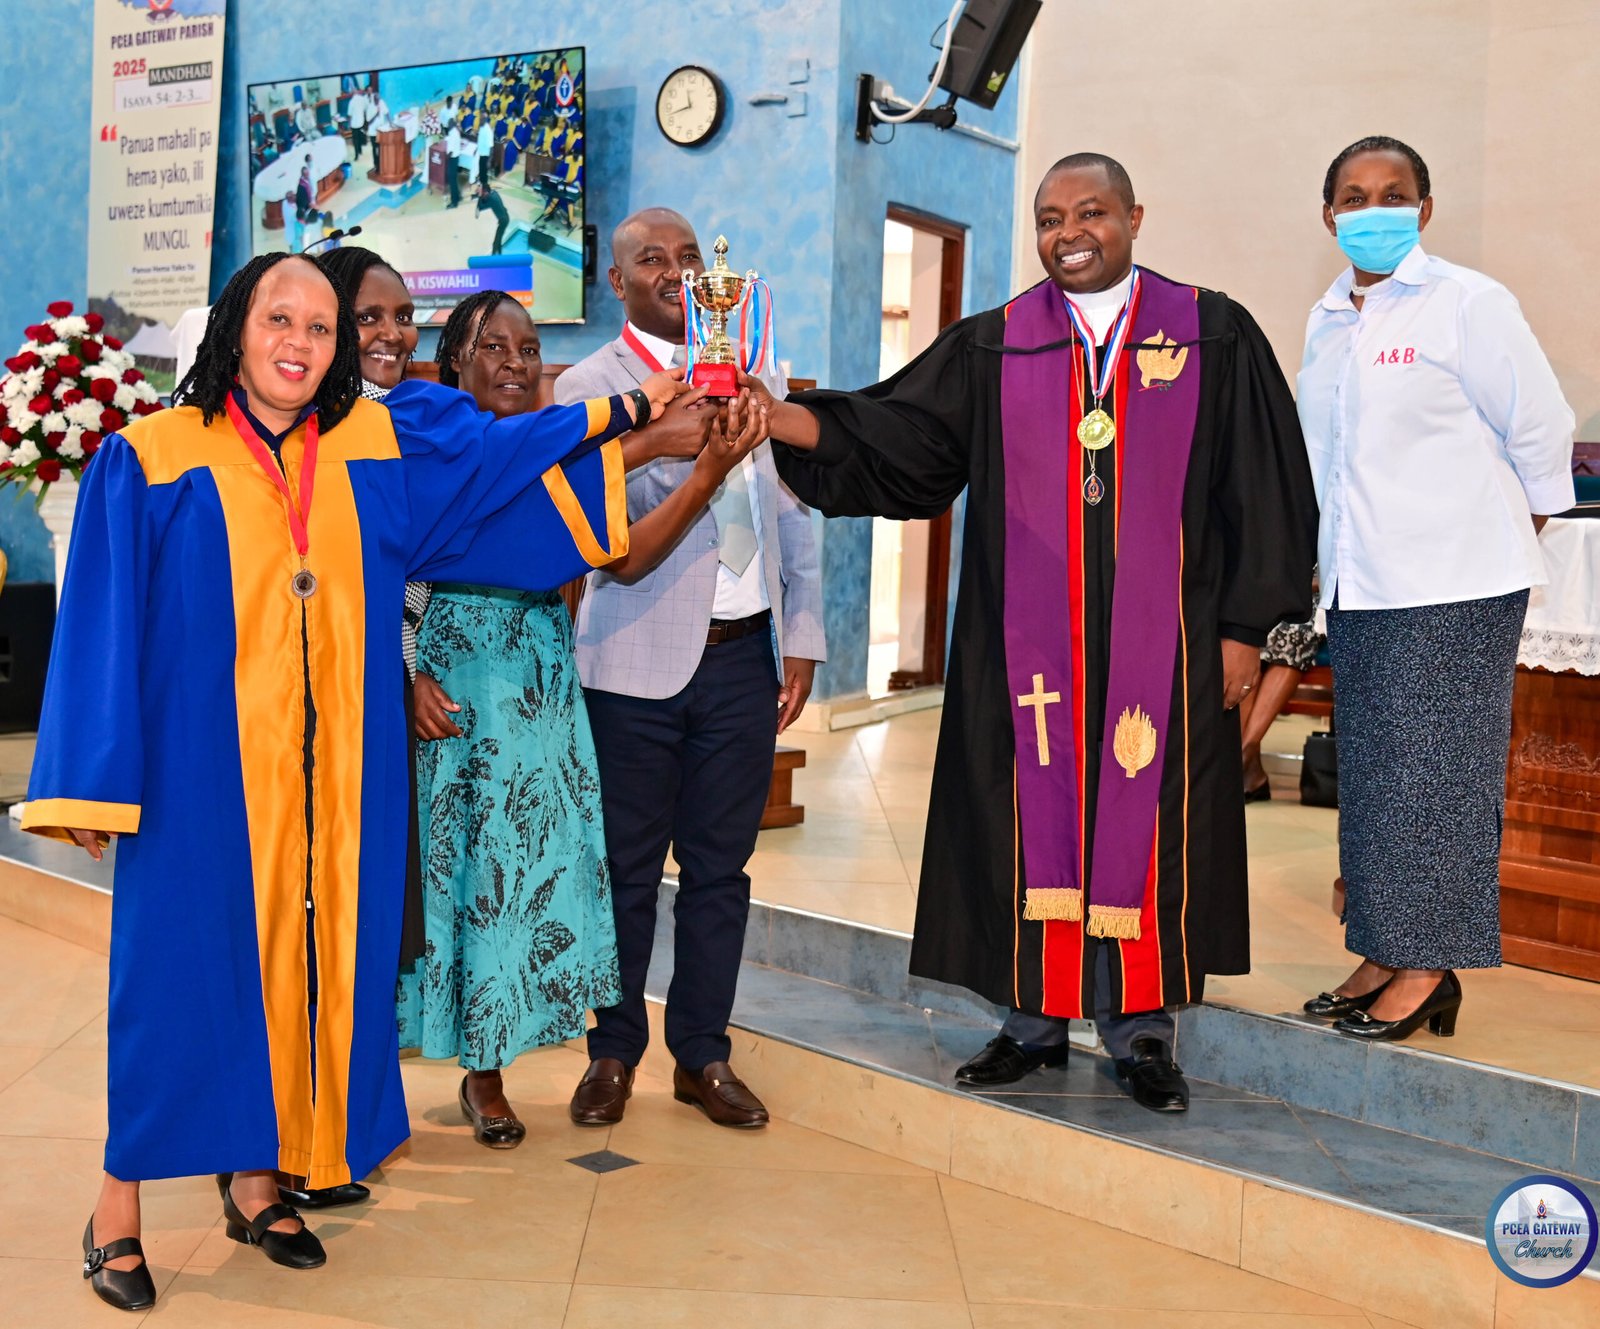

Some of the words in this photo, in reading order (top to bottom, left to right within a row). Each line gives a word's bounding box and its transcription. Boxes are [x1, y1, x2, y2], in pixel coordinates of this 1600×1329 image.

[111, 34, 134, 50] PCEA
[136, 27, 178, 46] GATEWAY
[180, 22, 214, 39] PARISH
[113, 58, 146, 77] 2025
[150, 63, 212, 84] MANDHARI
[157, 127, 197, 152] mahali
[200, 130, 212, 152] pa
[126, 168, 157, 188] hema
[160, 163, 190, 190] yako,
[193, 160, 204, 182] ili
[108, 202, 146, 220] uweze
[143, 229, 190, 251] MUNGU.
[417, 274, 480, 289] KISWAHILI
